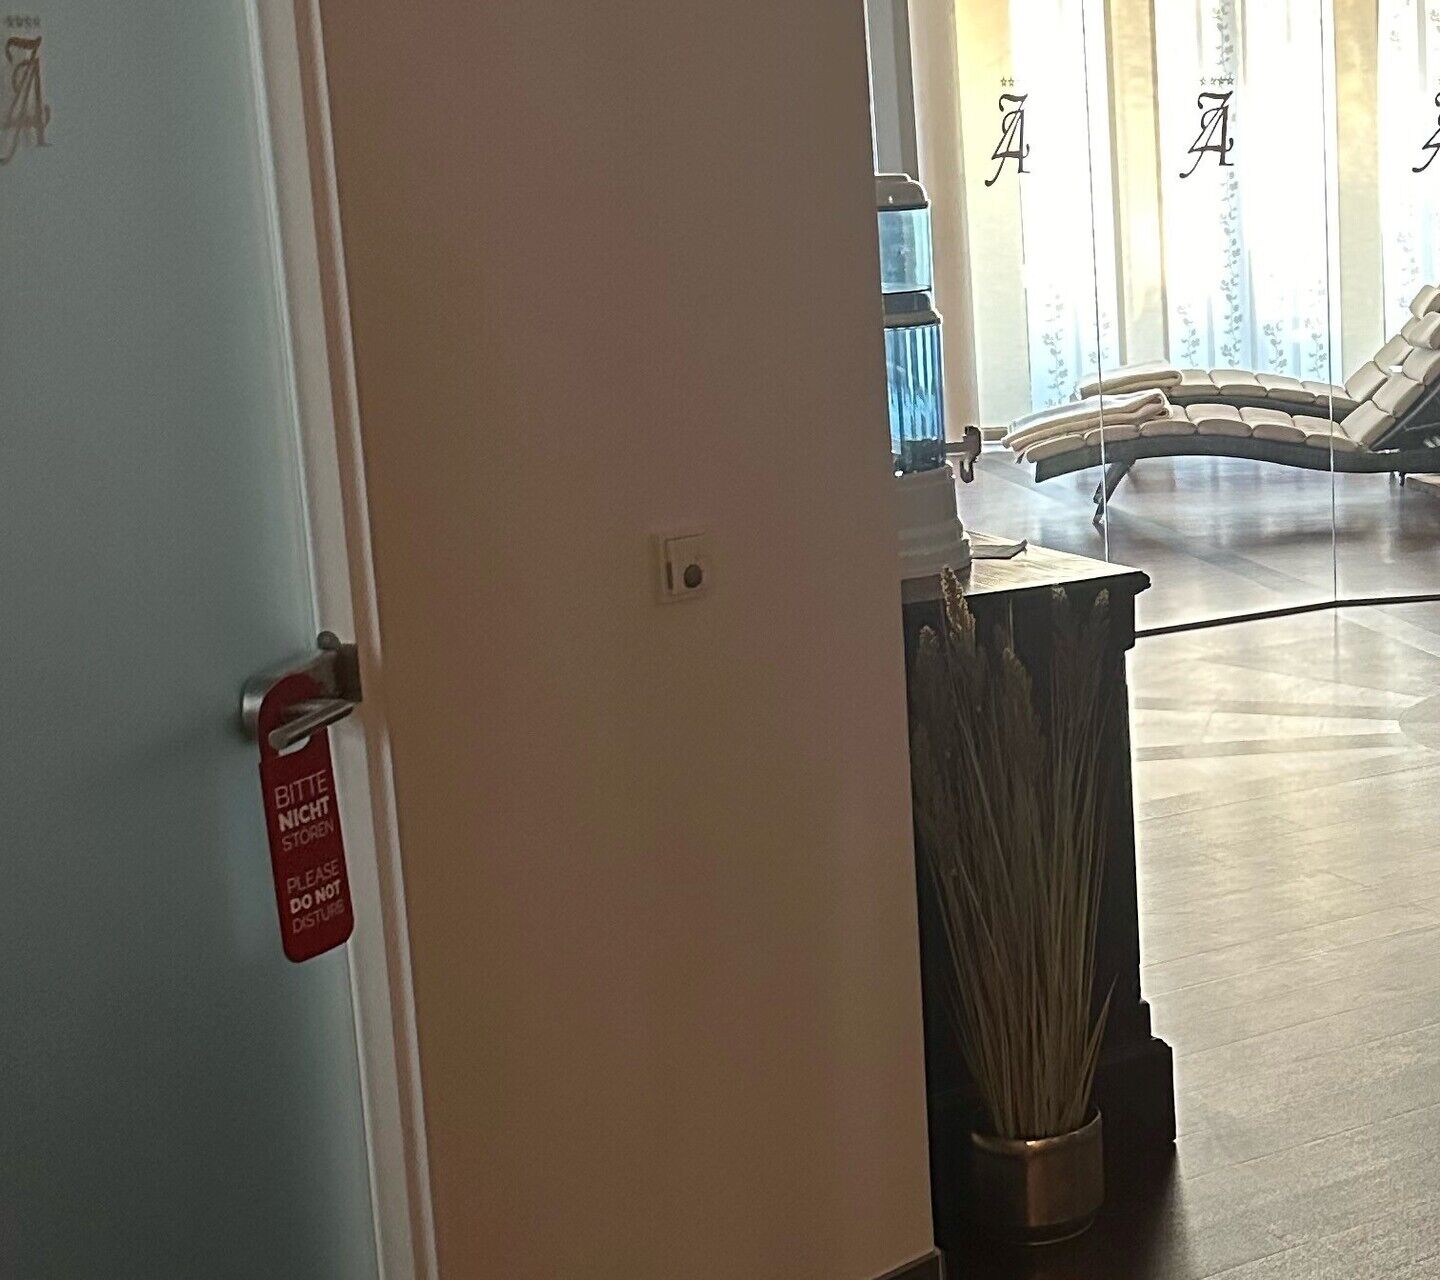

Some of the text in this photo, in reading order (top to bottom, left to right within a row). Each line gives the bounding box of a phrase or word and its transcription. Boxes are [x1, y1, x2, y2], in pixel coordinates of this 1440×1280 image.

[274, 769, 329, 809] BITTE
[277, 795, 330, 832] NICHT
[287, 860, 340, 894] PLEASE
[290, 879, 342, 914] DO NOT
[292, 898, 346, 934] DISTURB
